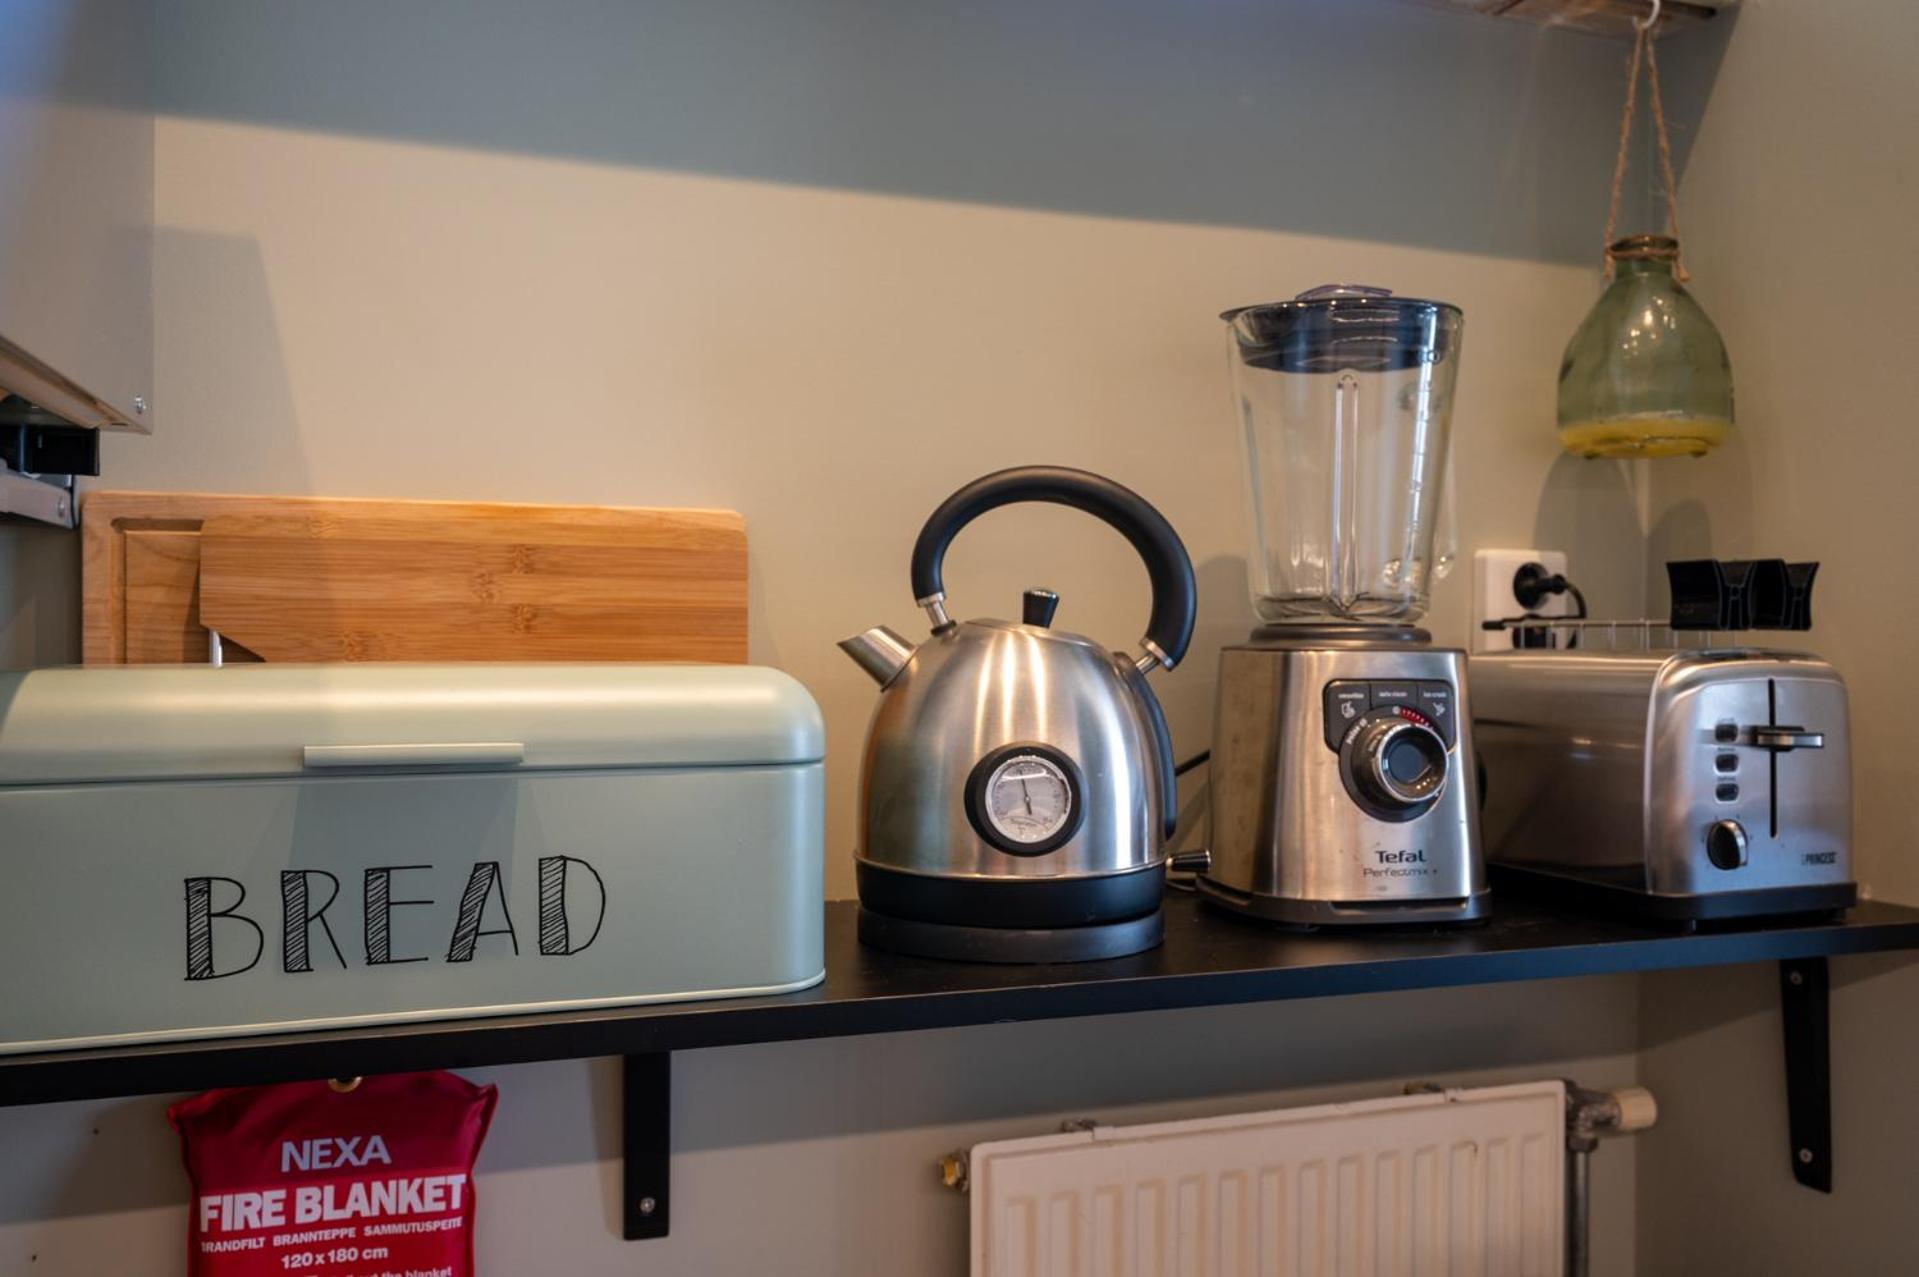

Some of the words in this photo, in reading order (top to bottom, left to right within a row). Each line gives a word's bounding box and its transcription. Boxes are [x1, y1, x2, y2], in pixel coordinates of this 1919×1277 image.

[1375, 849, 1427, 864] Tefal
[184, 854, 606, 981] BREAD
[281, 1135, 392, 1172] NEXA
[200, 1189, 286, 1233] FIRE
[294, 1174, 467, 1225] BLANKET
[272, 1227, 357, 1247] BRANNTEPPE
[281, 1252, 313, 1269] 120
[315, 1253, 325, 1265] x
[328, 1248, 358, 1263] 180
[362, 1247, 389, 1260] cm
